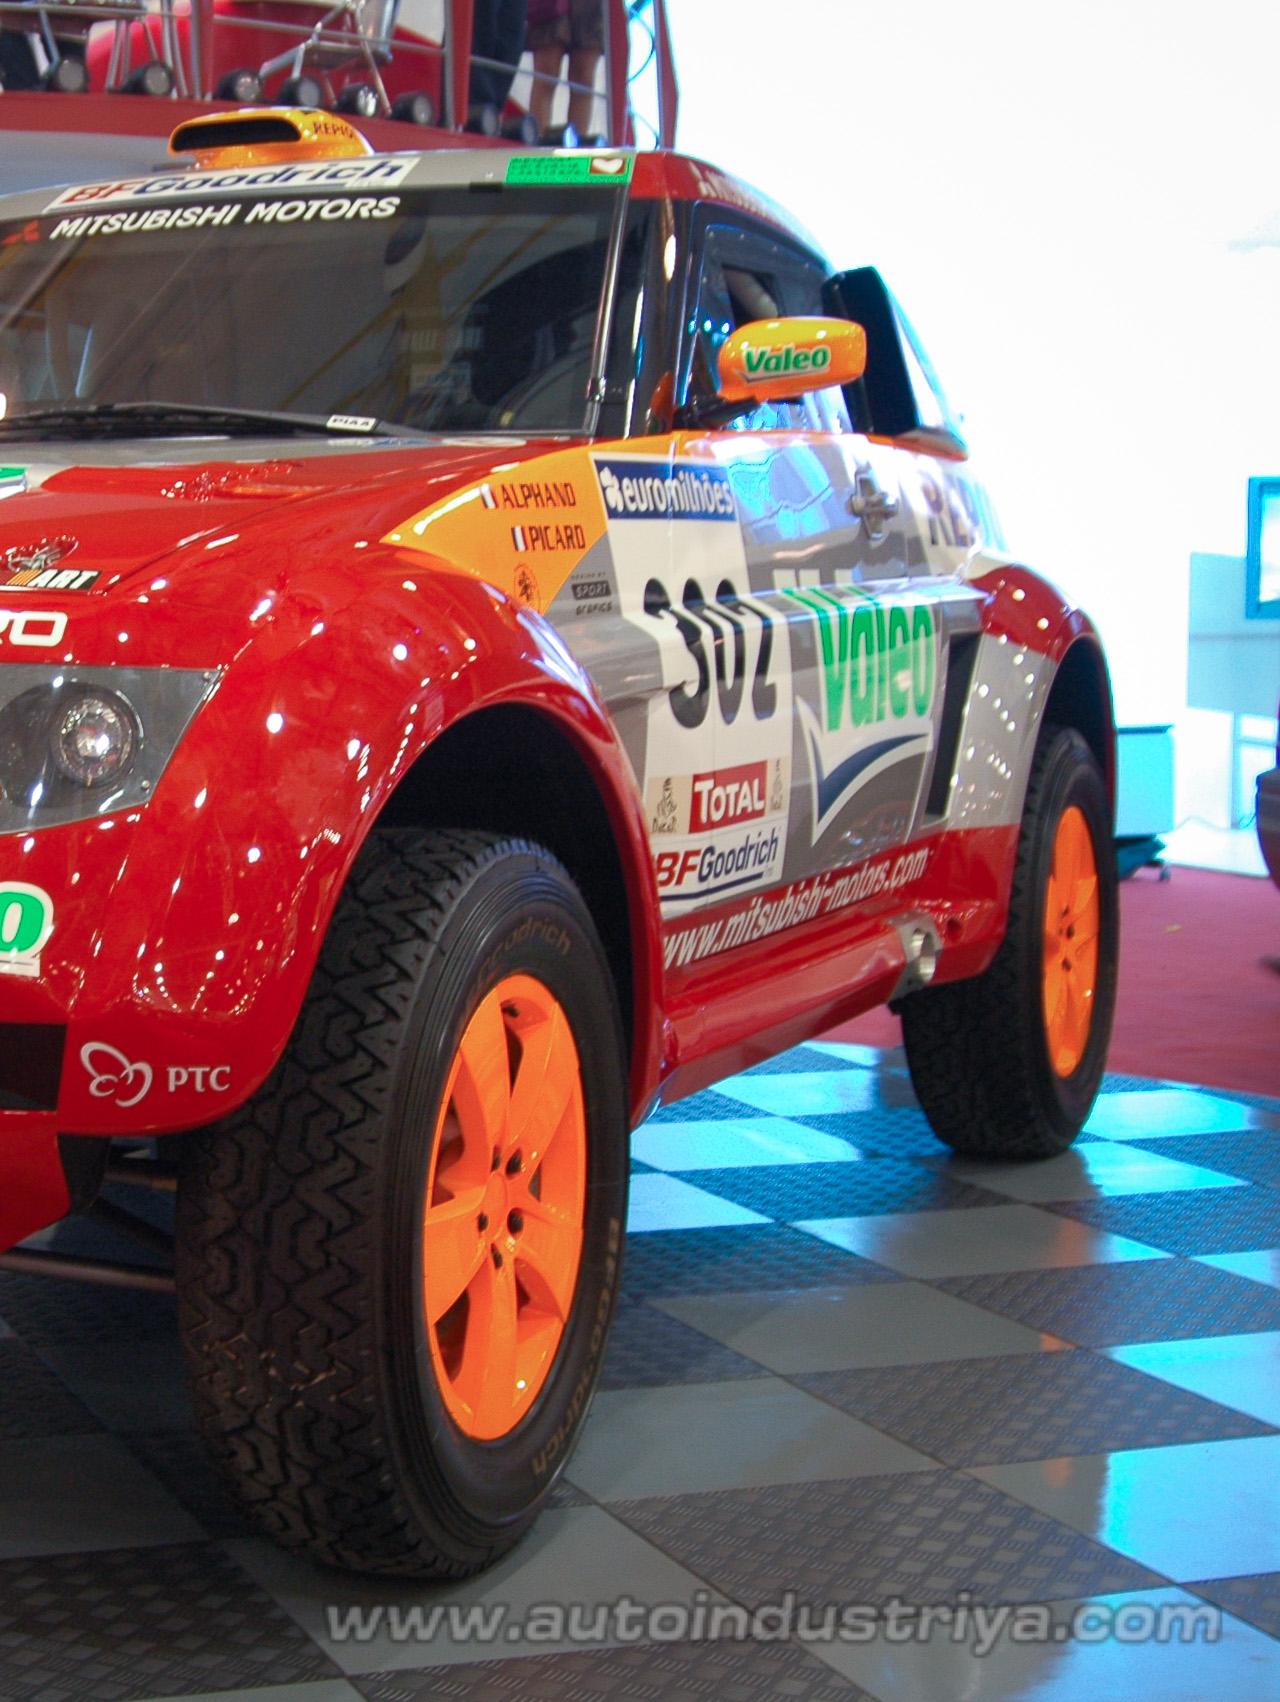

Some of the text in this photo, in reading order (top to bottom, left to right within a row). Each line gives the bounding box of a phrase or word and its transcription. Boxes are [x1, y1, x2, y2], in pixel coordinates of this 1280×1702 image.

[64, 160, 405, 203] BFGoodrich
[49, 196, 401, 240] MITSUBISHI MOTORS
[744, 345, 830, 373] Valeo
[500, 481, 577, 509] ALPHAND
[528, 524, 586, 551] PICARD
[643, 577, 778, 730] 302
[786, 588, 934, 732] Valeo
[655, 826, 779, 888] BFGoodrich
[663, 846, 930, 970] www.mitsubishi-motors.com
[166, 1064, 231, 1093] PTC
